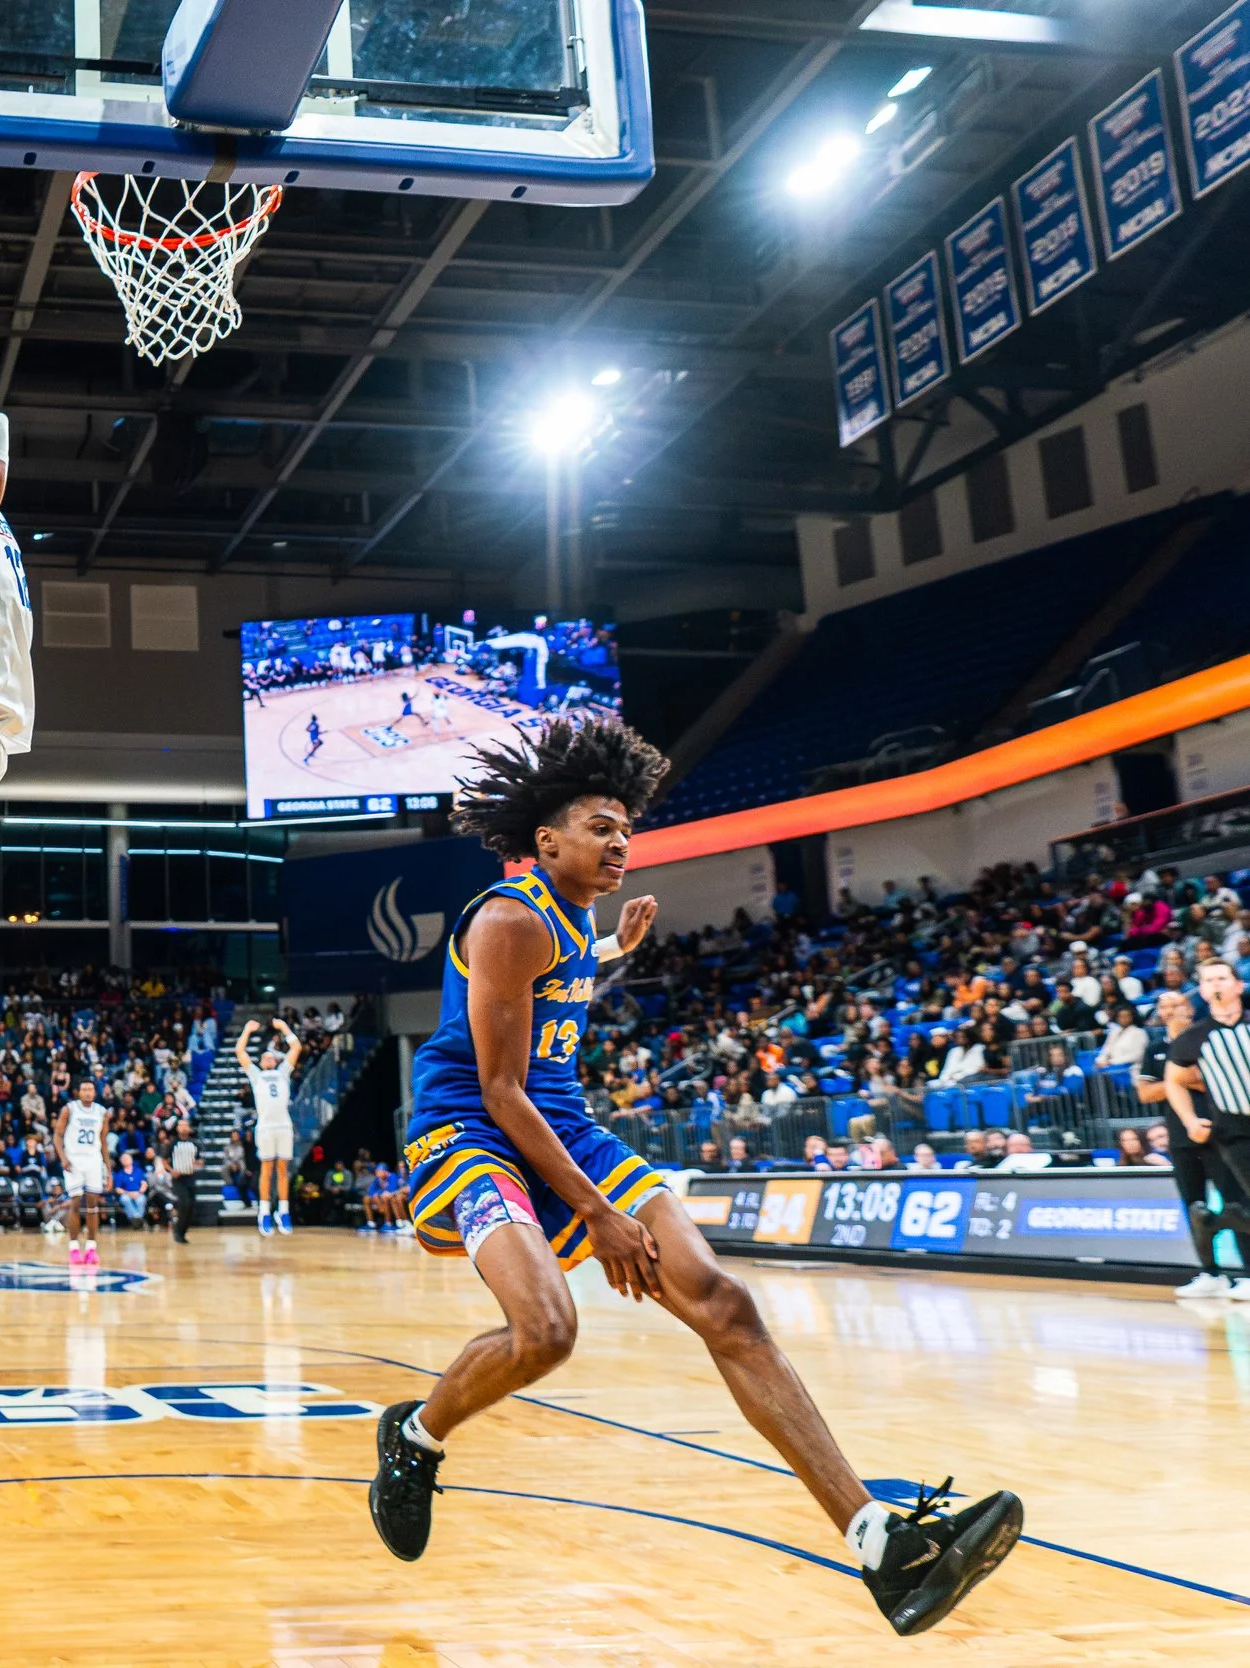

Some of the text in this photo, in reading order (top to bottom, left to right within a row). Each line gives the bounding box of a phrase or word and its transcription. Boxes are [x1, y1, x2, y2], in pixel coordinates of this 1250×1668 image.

[1111, 150, 1166, 203] 2019
[367, 797, 392, 811] 62
[536, 1019, 580, 1064] 13
[77, 1129, 95, 1144] 20
[759, 1192, 807, 1234] 34
[823, 1182, 899, 1221] 13:08
[901, 1190, 963, 1238] 62
[1001, 1191, 1017, 1212] 4
[995, 1218, 1014, 1240] 2
[1026, 1206, 1181, 1232] GEORGIA STATE
